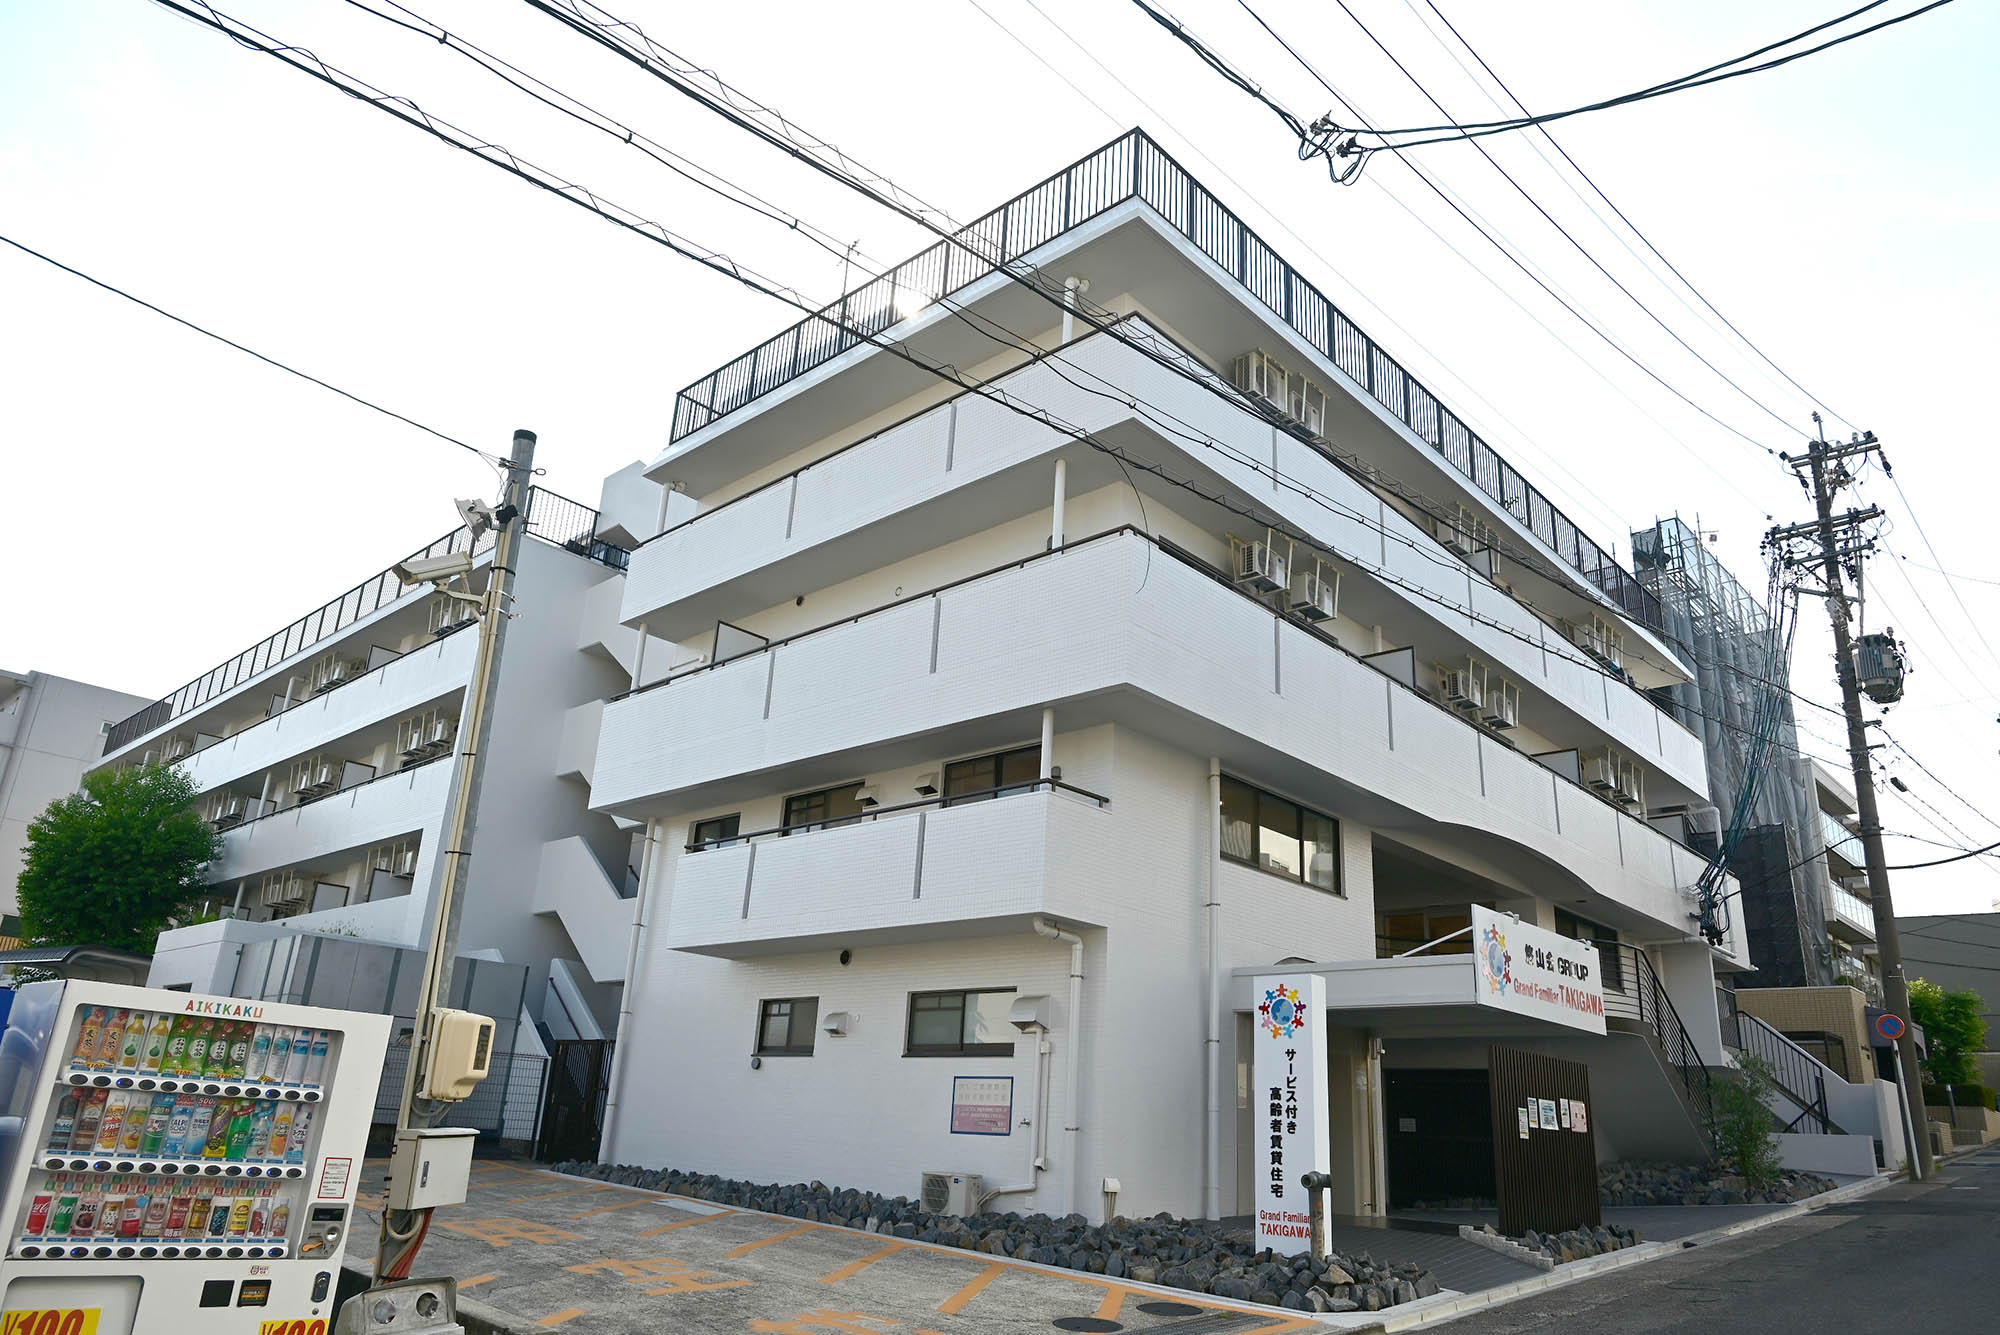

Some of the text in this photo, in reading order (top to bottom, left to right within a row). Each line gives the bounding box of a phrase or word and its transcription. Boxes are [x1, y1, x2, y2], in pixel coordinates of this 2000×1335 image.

[185, 999, 264, 1019] AIKIKAKU
[1513, 978, 1533, 998] Grand
[1559, 984, 1604, 1017] TAKIGAWA
[1285, 1048, 1297, 1135] サービス付き
[1269, 1087, 1283, 1199] 高齢者賃貸住宅
[1260, 1209, 1281, 1221] Grand
[1260, 1222, 1312, 1239] TAKIGAWA
